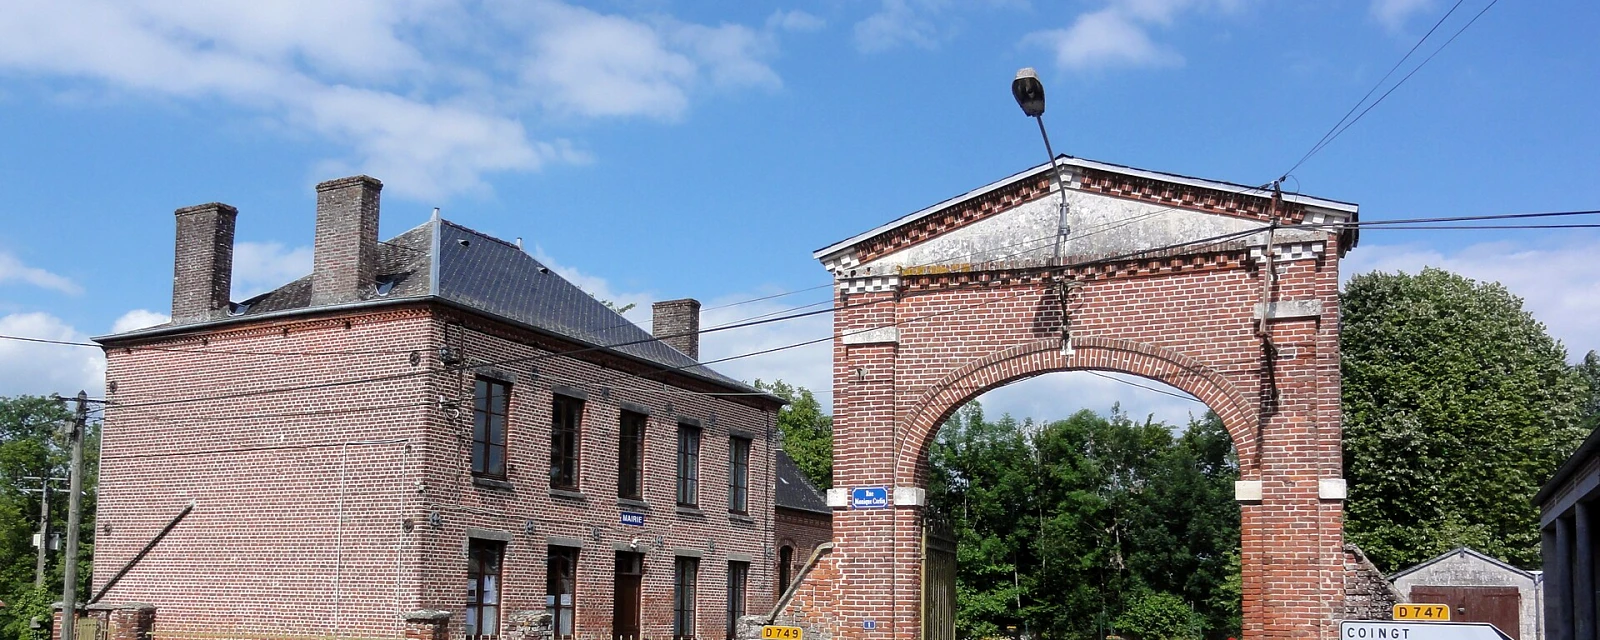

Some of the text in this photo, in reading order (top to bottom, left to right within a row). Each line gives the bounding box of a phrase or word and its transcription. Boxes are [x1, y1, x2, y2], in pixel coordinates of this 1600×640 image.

[622, 514, 643, 524] MAIRIE
[1399, 606, 1444, 618] D 747
[765, 627, 799, 639] D 749
[1347, 627, 1410, 639] COINGT
